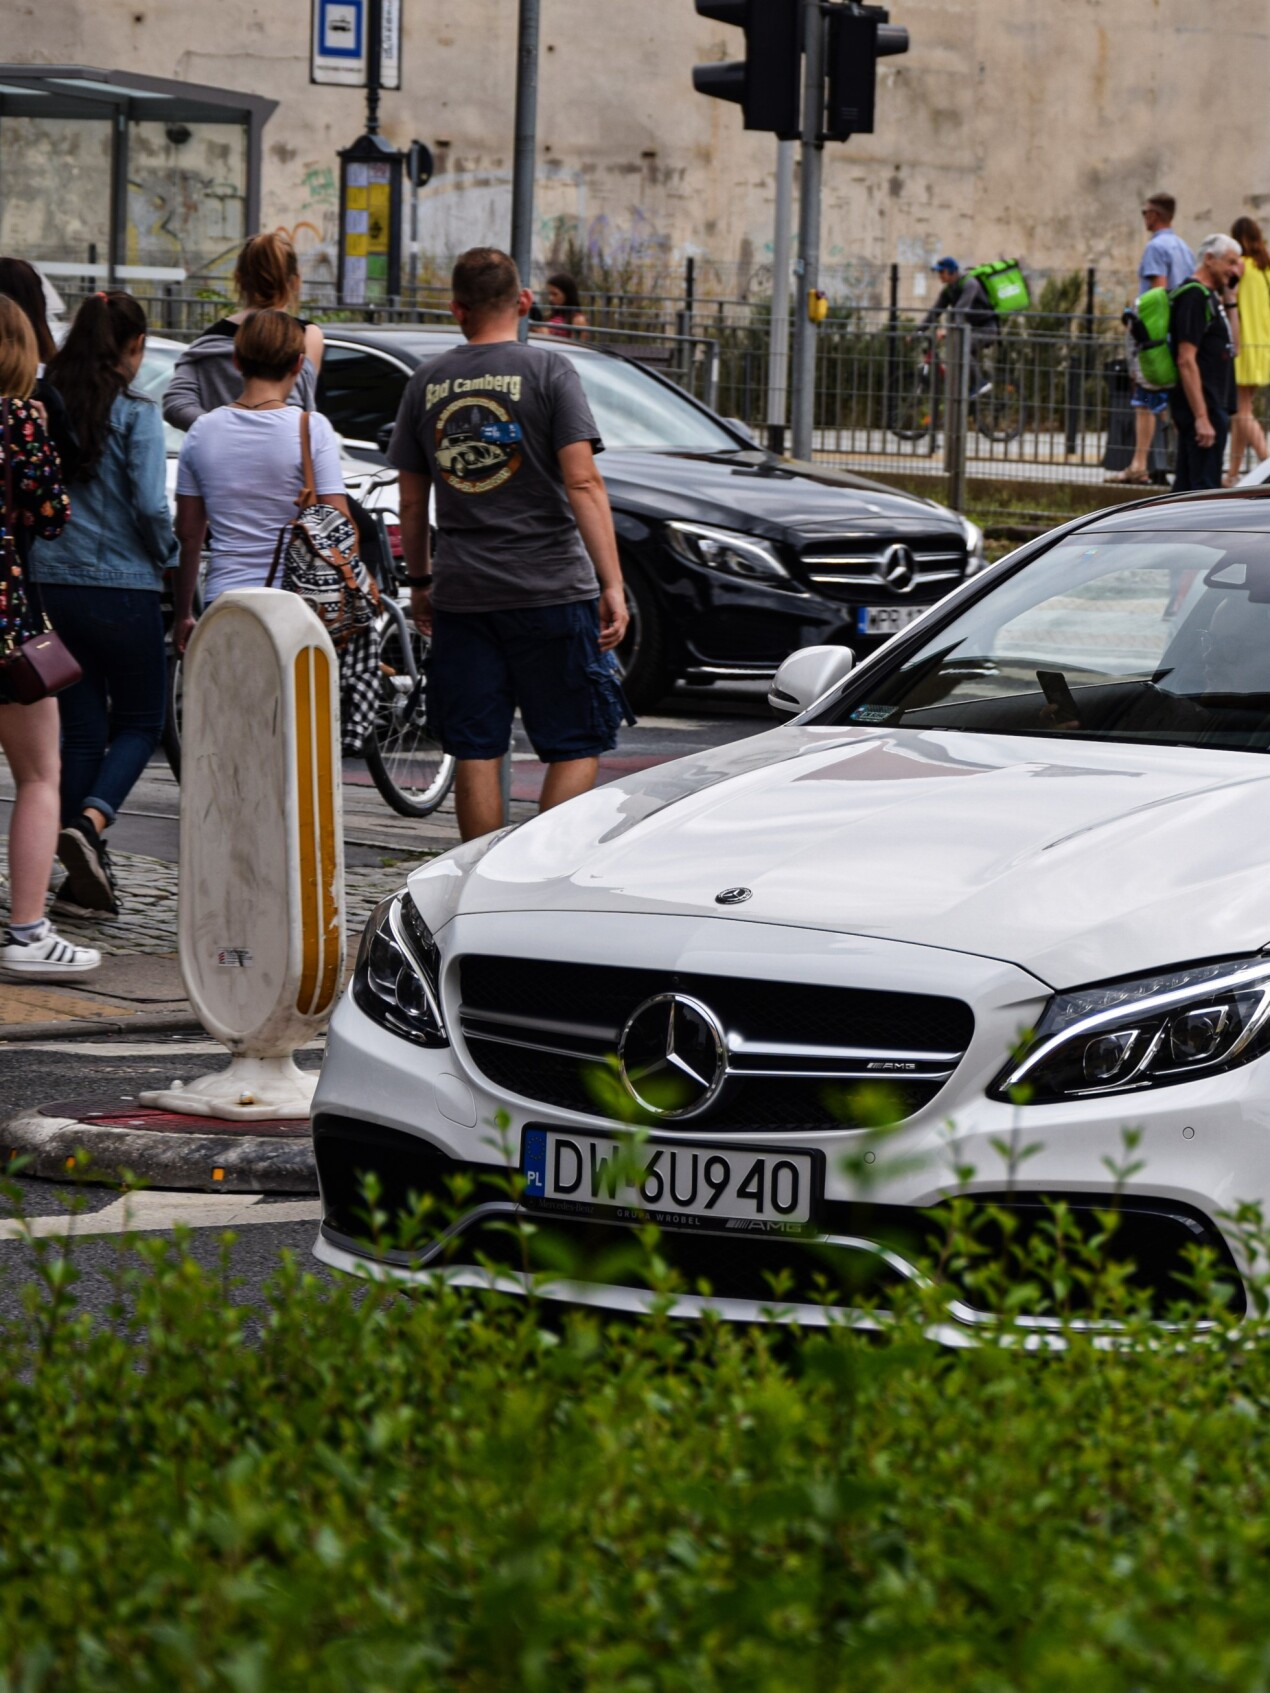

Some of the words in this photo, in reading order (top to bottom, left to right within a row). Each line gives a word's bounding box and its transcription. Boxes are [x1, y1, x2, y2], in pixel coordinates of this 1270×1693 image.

[426, 380, 450, 410] Bad
[453, 374, 522, 401] Camberg
[527, 1171, 542, 1187] PL
[554, 1138, 620, 1200] DW
[640, 1150, 800, 1215] 6U940
